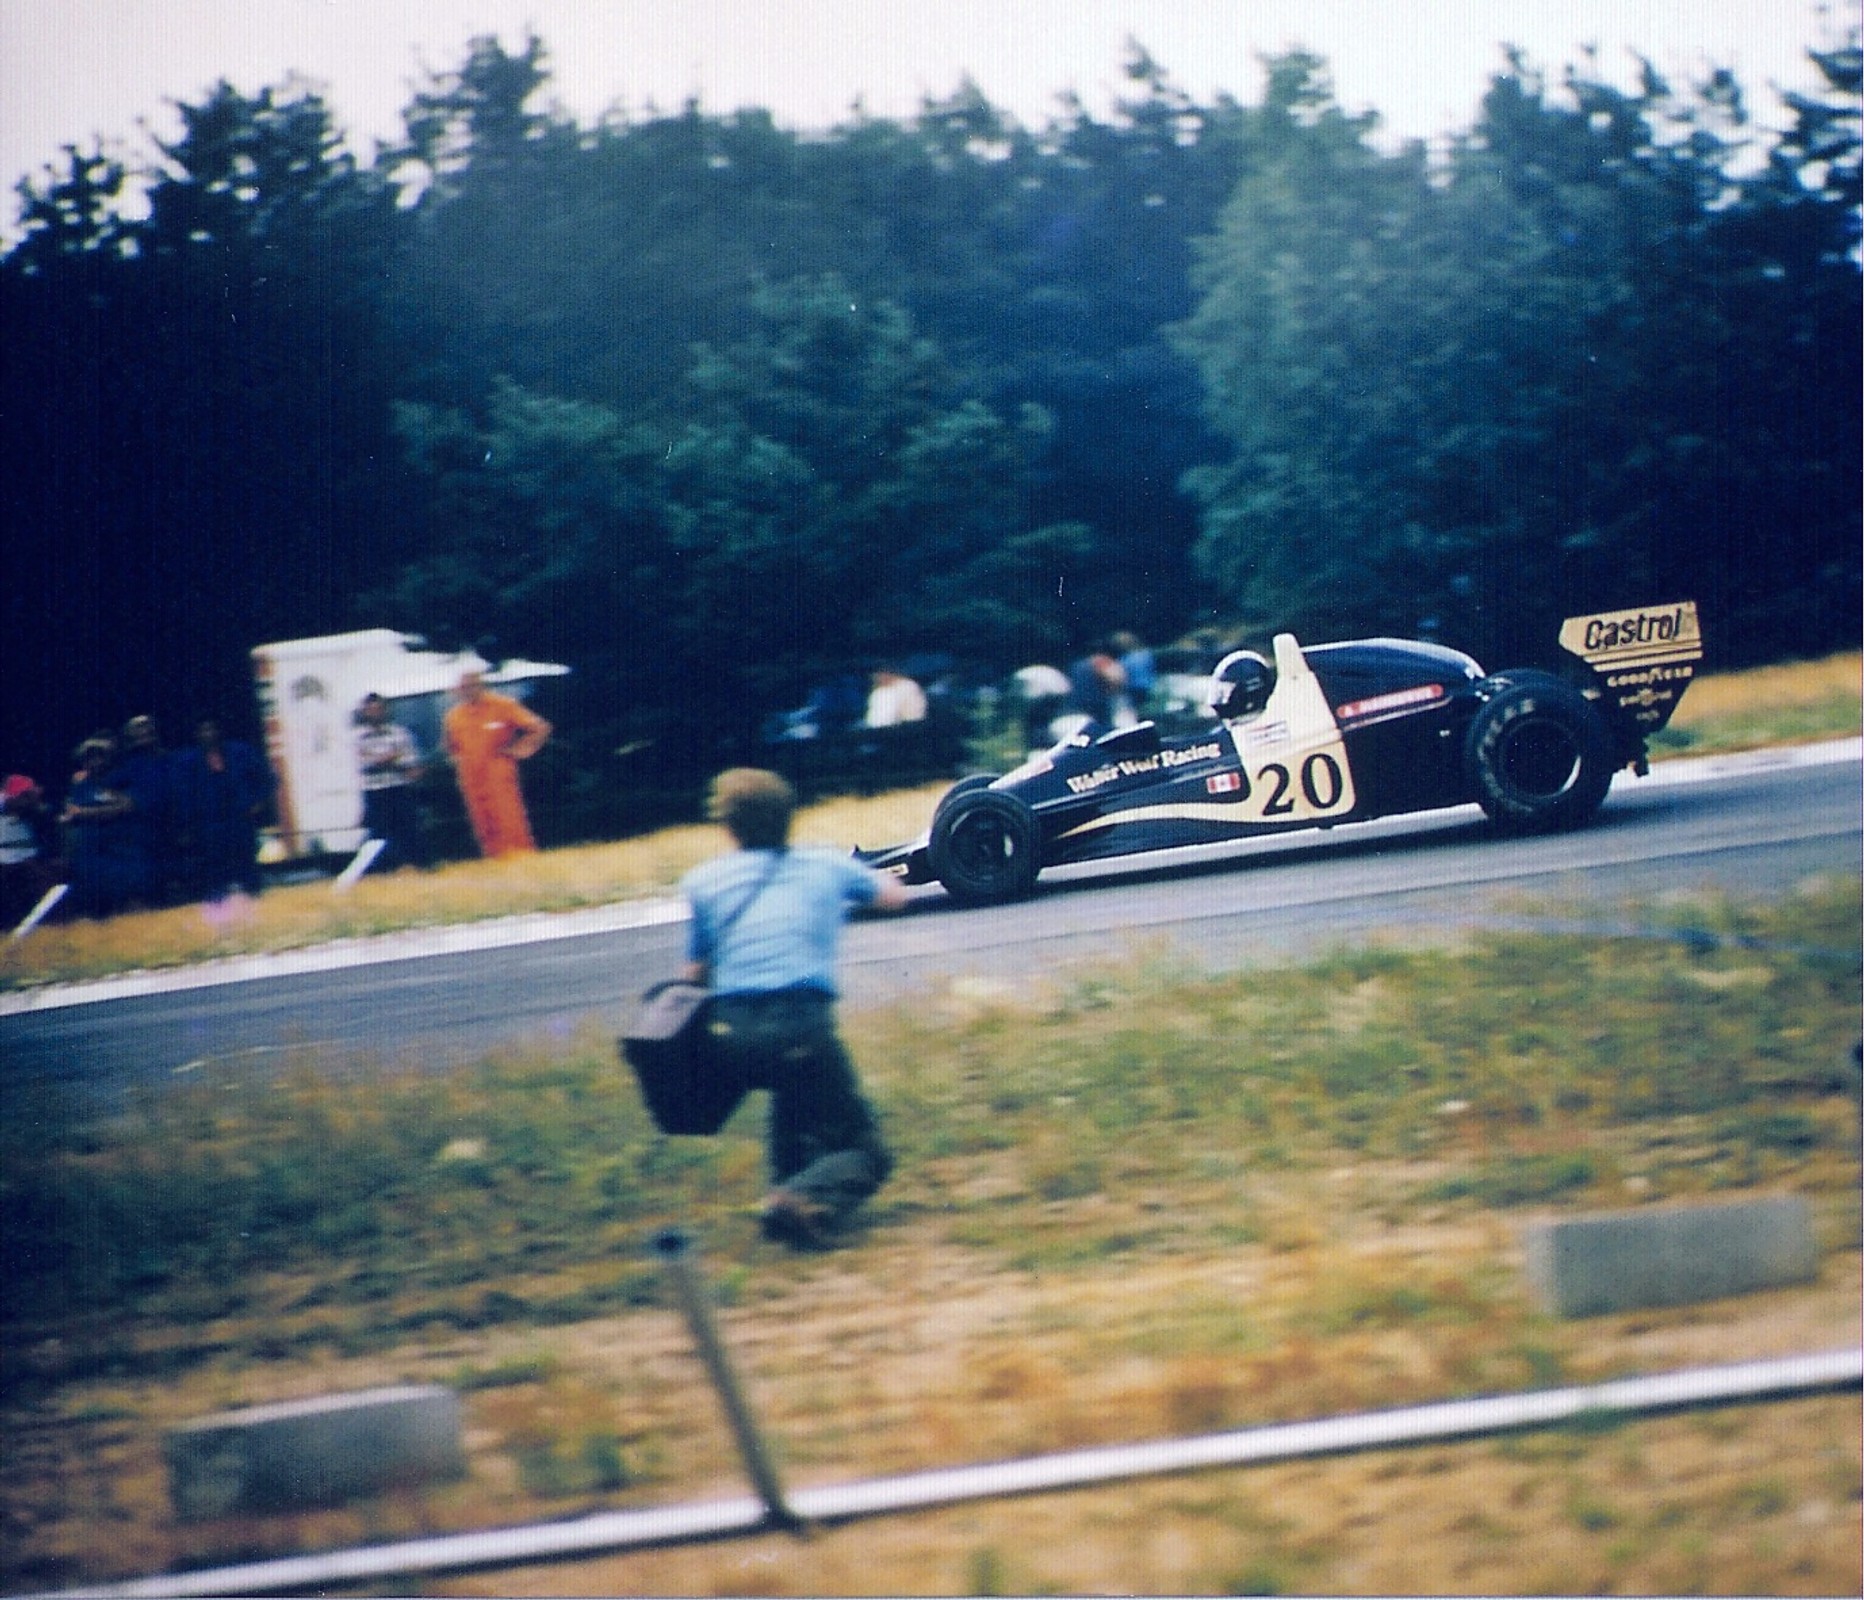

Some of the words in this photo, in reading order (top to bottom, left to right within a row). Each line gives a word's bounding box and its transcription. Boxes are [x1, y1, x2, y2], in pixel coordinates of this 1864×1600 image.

[1584, 607, 1682, 650] Castrol
[1160, 742, 1221, 768] Racing
[1257, 753, 1342, 816] 20
